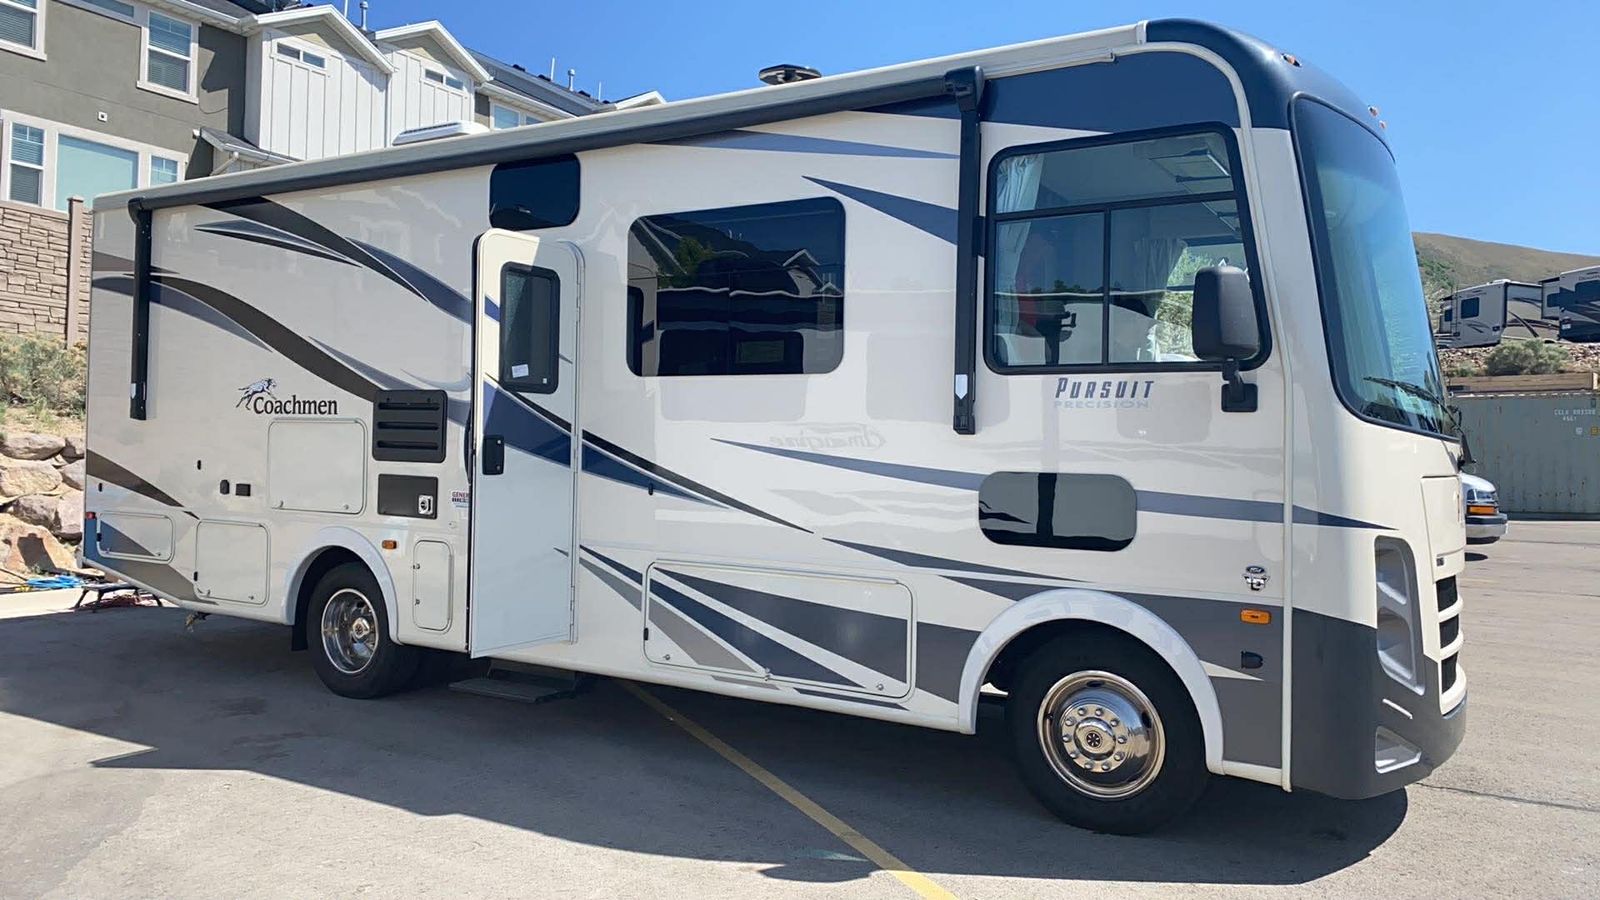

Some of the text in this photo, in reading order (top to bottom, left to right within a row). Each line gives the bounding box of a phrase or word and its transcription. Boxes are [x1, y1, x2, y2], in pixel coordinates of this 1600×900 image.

[1055, 377, 1154, 399] PURSUIT
[253, 394, 338, 415] Coachmen
[1054, 400, 1150, 409] PRECISION
